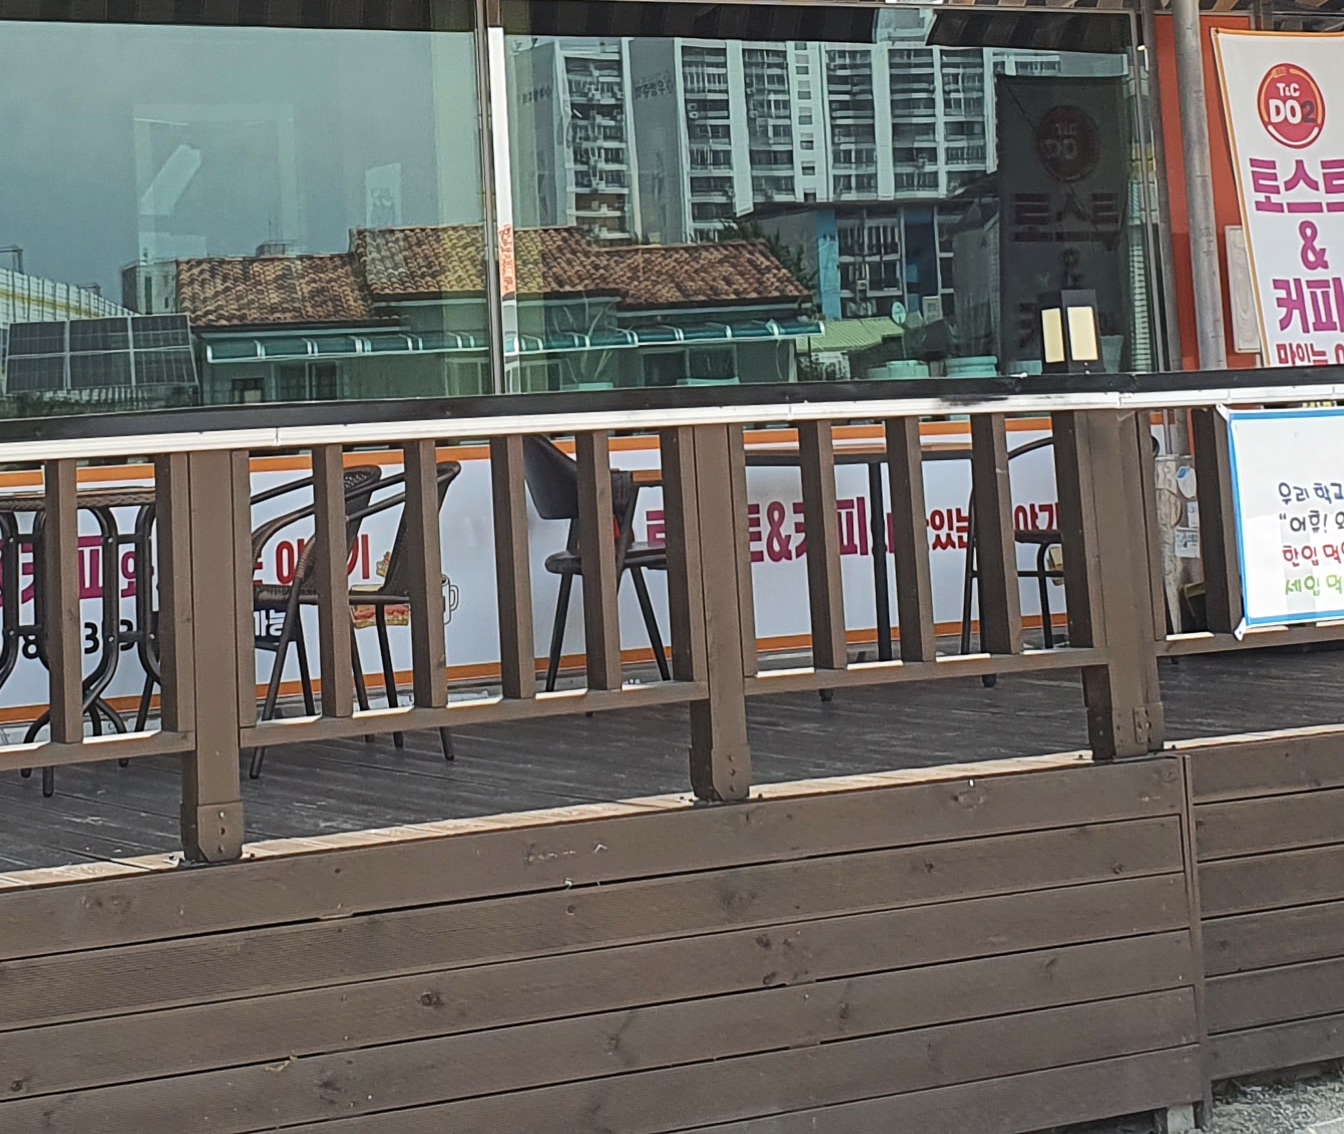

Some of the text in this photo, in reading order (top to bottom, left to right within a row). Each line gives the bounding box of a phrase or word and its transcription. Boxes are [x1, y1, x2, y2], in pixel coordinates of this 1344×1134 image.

[1276, 82, 1301, 97] T&C
[1269, 98, 1316, 124] DO2
[1298, 220, 1329, 270] &
[1278, 482, 1310, 505] 우리
[1282, 545, 1320, 567] 한입
[1285, 575, 1320, 597] 세입
